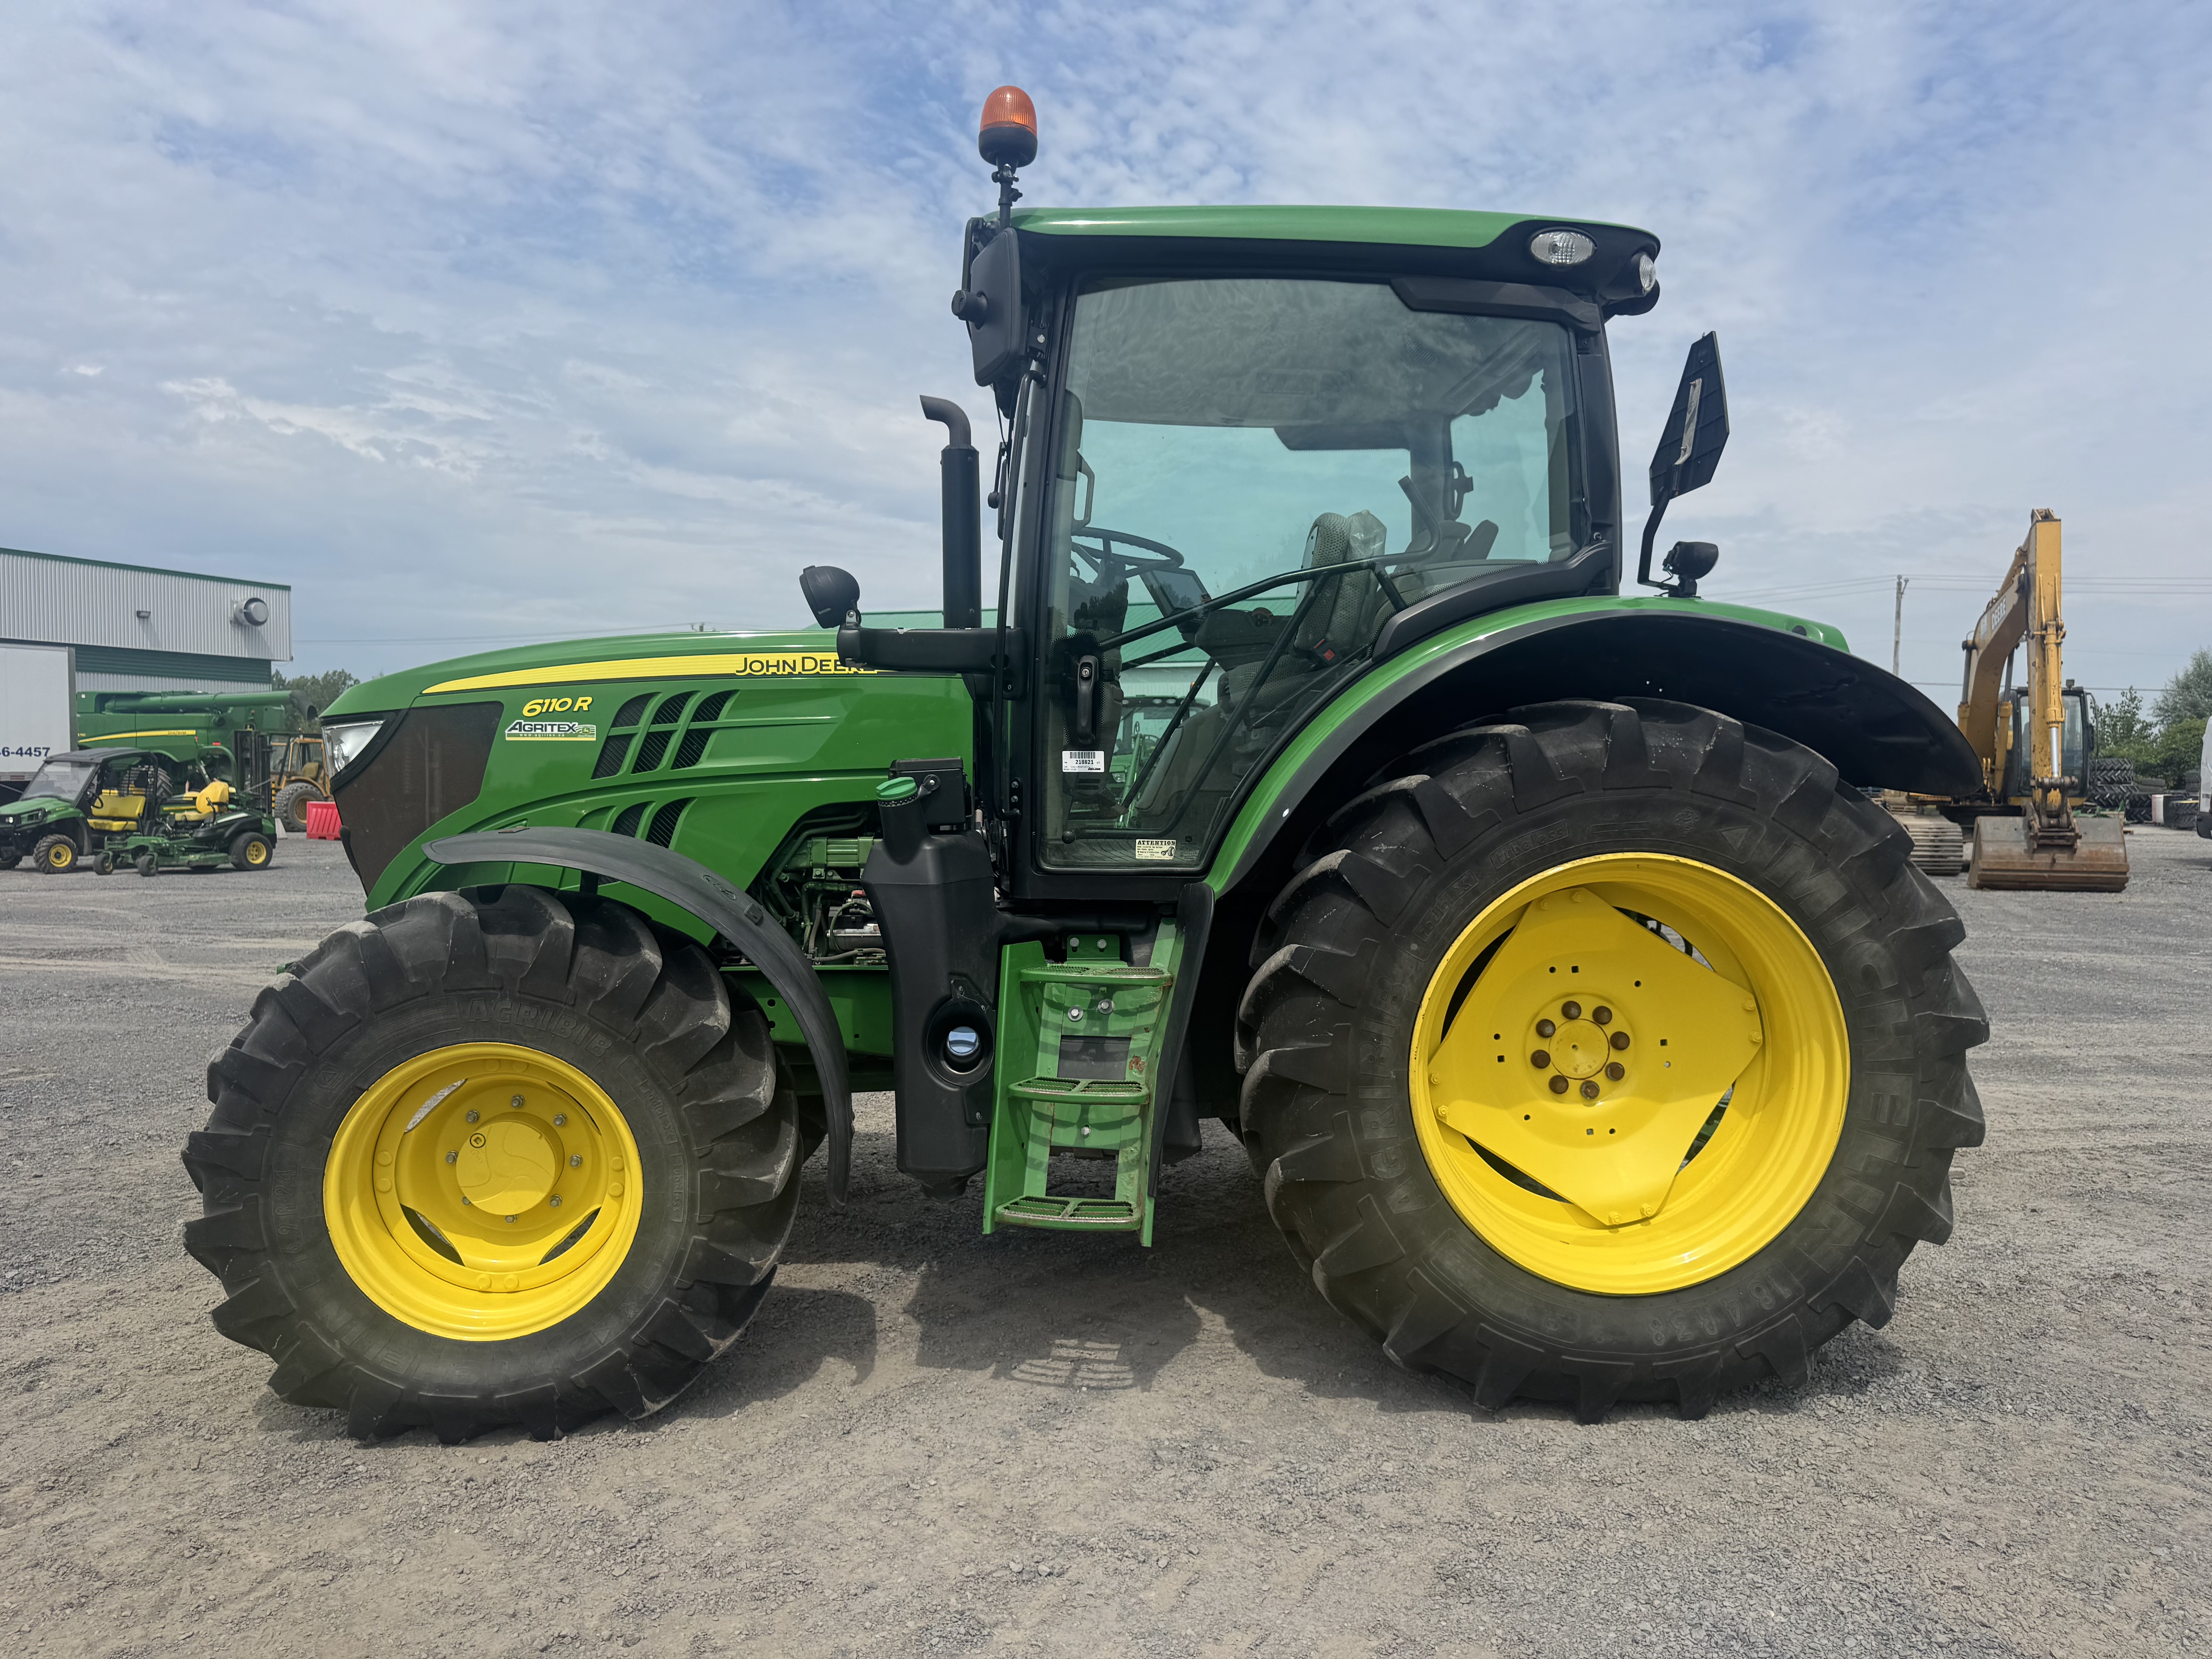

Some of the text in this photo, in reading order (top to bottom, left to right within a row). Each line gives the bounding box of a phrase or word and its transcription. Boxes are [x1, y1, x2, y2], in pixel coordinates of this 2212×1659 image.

[1992, 597, 2006, 630] DEERE
[736, 656, 874, 673] JOHN DEE
[508, 721, 577, 732] AGRITEX
[0, 747, 50, 757] 6-4457
[467, 998, 613, 1057] AGRIBIB
[1764, 842, 1914, 1273] MICHELIN
[1358, 976, 1428, 1214] AGRIBIB
